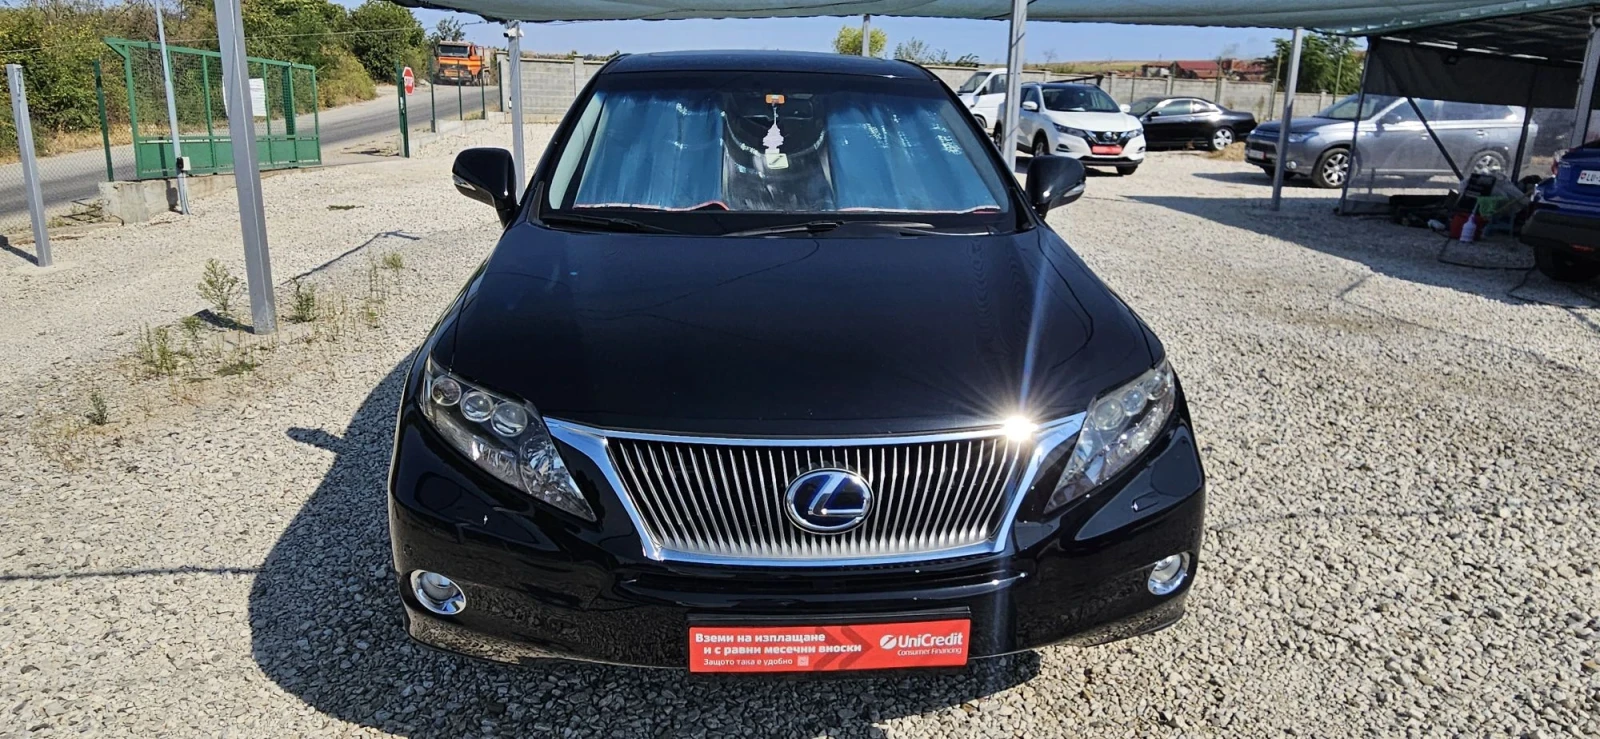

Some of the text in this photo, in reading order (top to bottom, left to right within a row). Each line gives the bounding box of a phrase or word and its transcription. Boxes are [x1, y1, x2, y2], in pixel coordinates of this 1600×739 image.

[695, 633, 826, 643] Вземи на изплащане
[899, 632, 963, 647] UniCredit
[704, 646, 711, 654] и
[724, 646, 761, 656] равни
[764, 645, 816, 654] месечни
[818, 644, 862, 653] вноски
[898, 647, 962, 656] Consumer Financing
[703, 658, 734, 666] Защото
[764, 657, 793, 666] удобно
